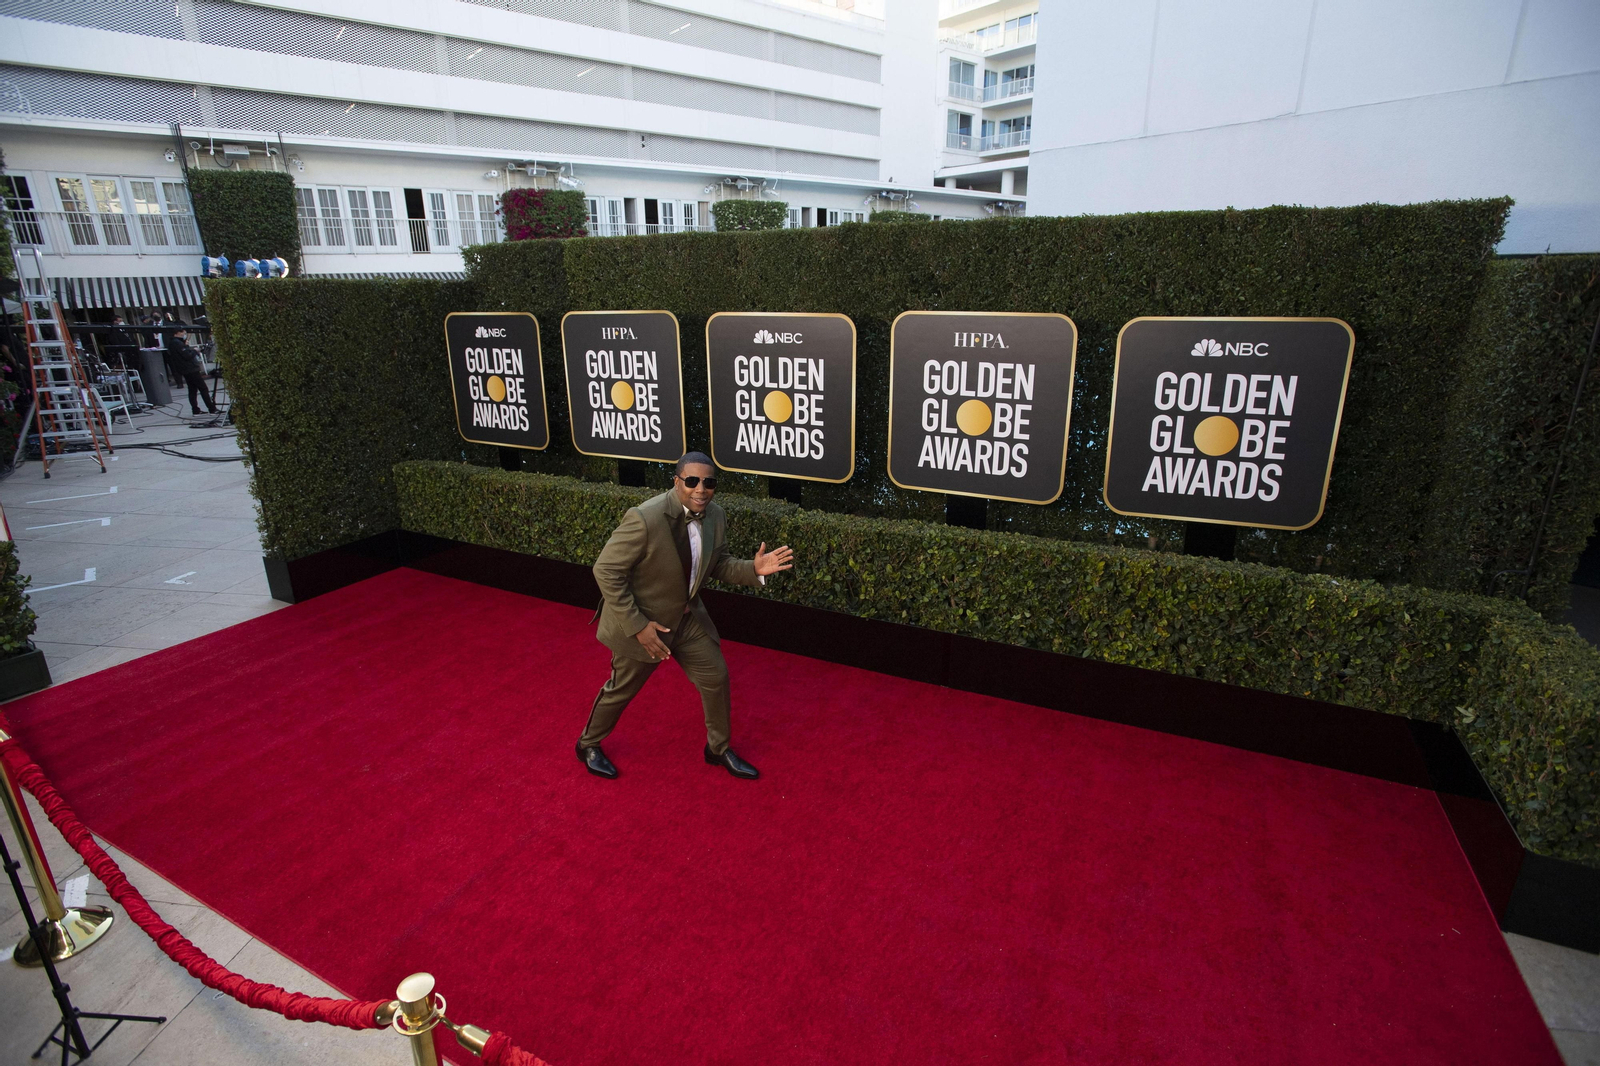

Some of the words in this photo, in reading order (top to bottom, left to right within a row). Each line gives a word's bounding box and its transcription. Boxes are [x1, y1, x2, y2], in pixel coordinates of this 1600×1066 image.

[487, 327, 507, 338] NBC
[774, 332, 803, 345] NBC
[1224, 342, 1269, 357] NBC
[464, 347, 524, 376] GOLDEN
[585, 350, 658, 381] GOLDEN
[734, 355, 824, 391] GOLDEN
[468, 375, 527, 404] GLOBE
[588, 380, 660, 412] GLOBE
[923, 359, 1036, 401] GOLDEN
[1154, 371, 1298, 416] GOLDEN
[472, 402, 530, 432] AWARDS
[735, 390, 825, 427] GLOBE
[921, 397, 1033, 441] GLOBE
[591, 410, 662, 443] AWARDS
[735, 422, 825, 460] AWARDS
[1149, 414, 1291, 461] GLOBE
[917, 435, 1029, 478] AWARDS
[1141, 455, 1283, 502] AWARDS
